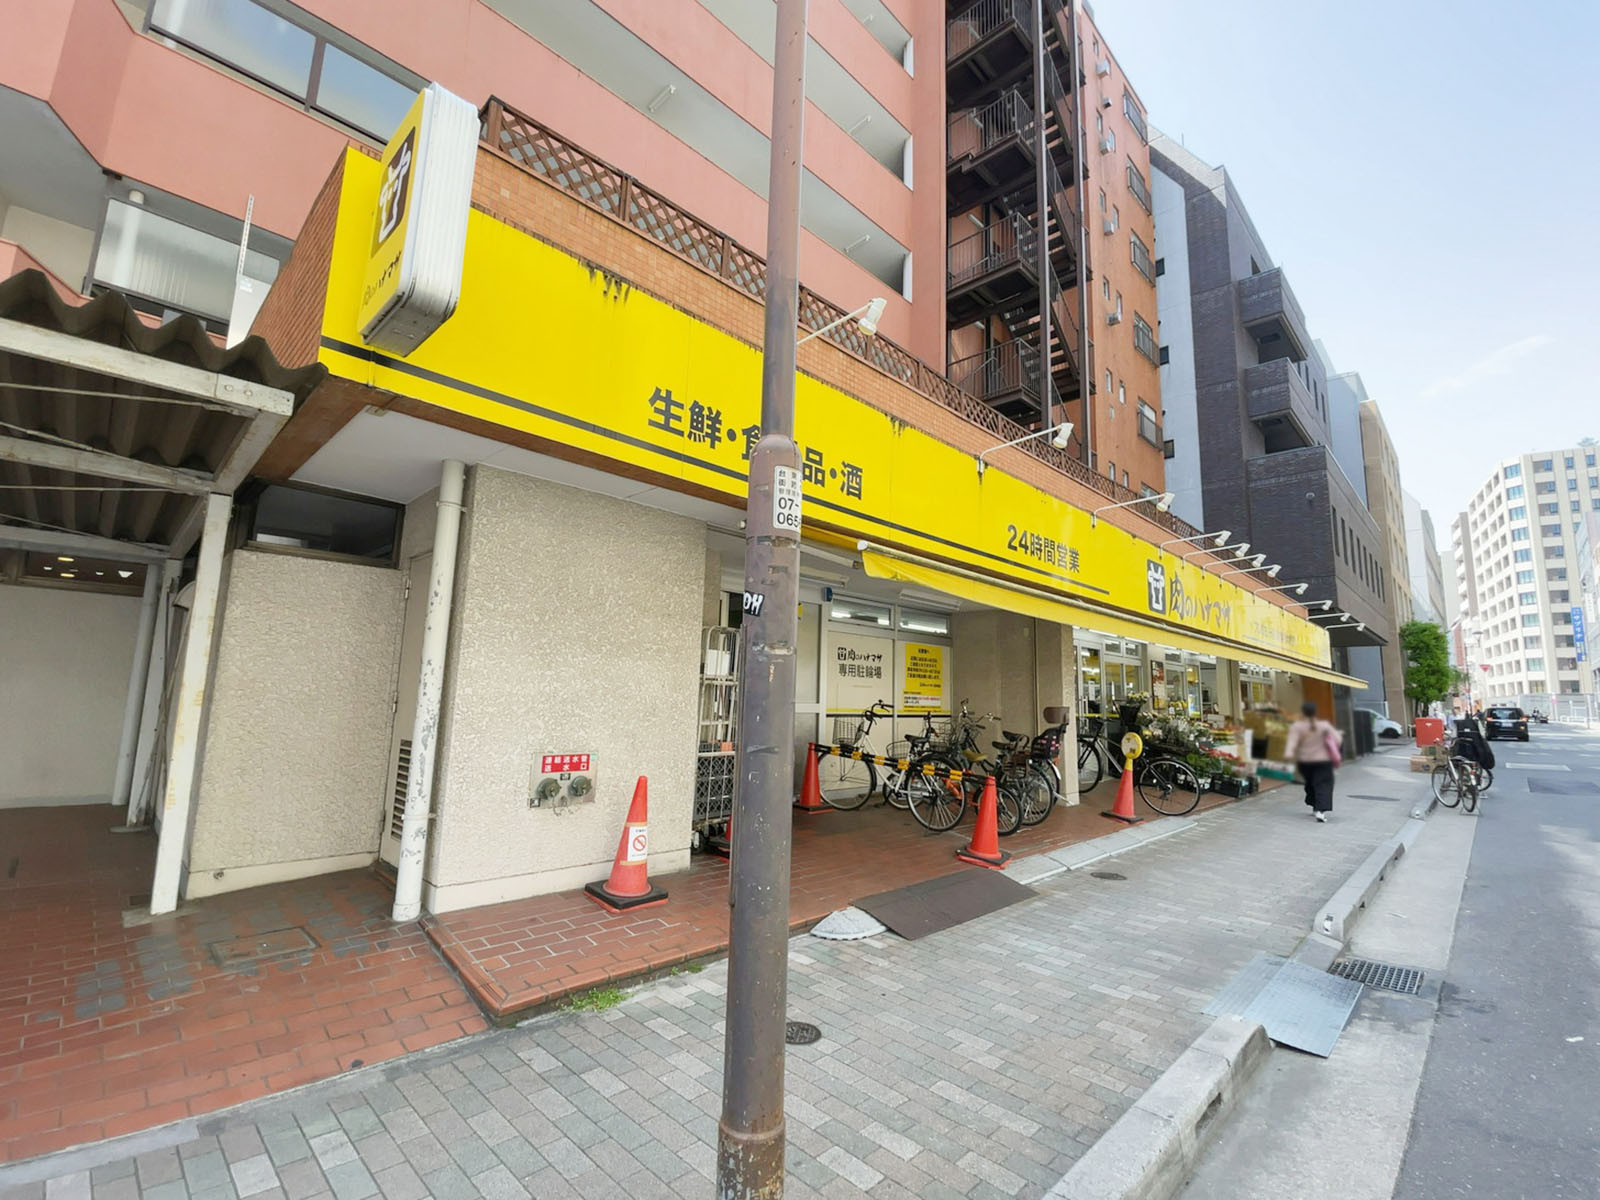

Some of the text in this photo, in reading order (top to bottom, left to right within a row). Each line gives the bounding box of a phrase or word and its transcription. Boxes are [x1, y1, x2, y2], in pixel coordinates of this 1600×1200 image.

[1007, 524, 1080, 573] 24時間営業
[1168, 571, 1231, 635] 肉のハナマサ
[838, 663, 881, 679] 専用駐輪場
